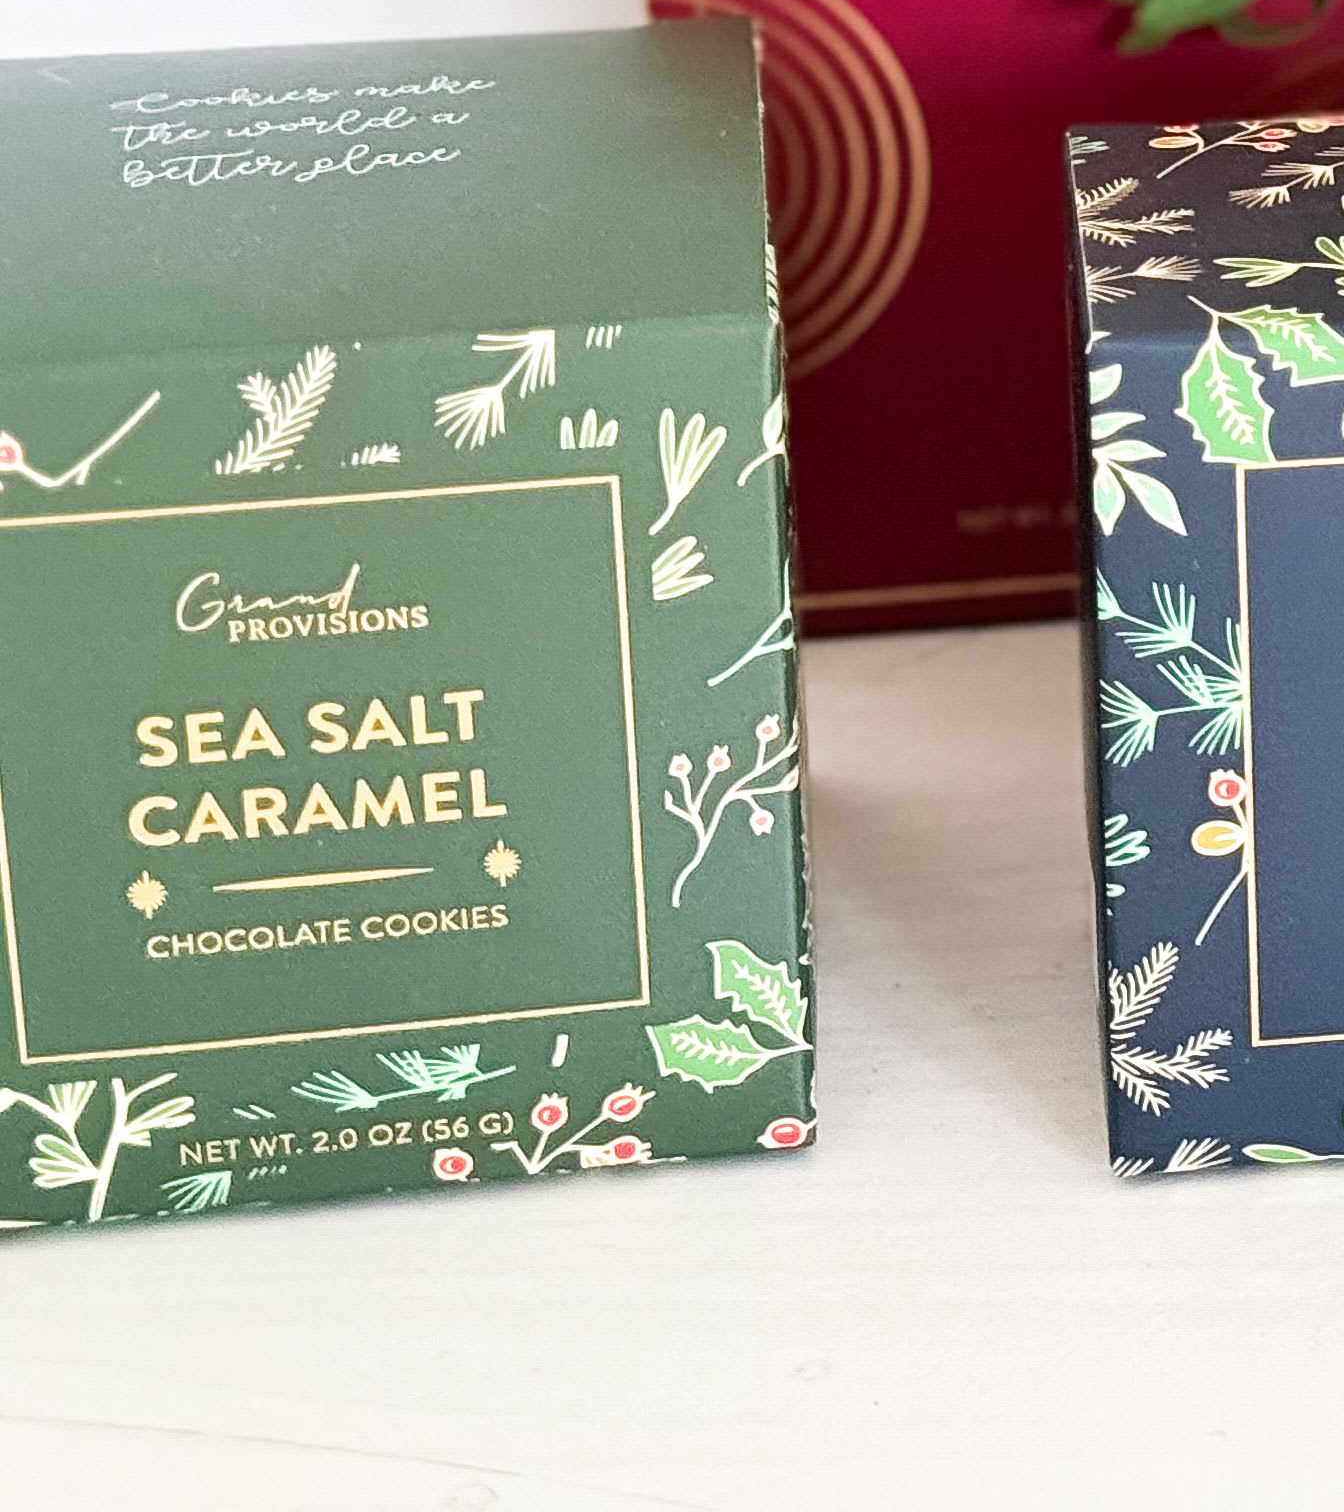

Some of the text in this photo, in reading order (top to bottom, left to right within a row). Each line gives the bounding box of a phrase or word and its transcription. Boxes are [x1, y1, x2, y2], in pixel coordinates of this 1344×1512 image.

[110, 74, 497, 113] Cookies make
[110, 107, 471, 151] the world a
[294, 143, 464, 183] place
[176, 563, 360, 633] Grand
[228, 604, 429, 643] PROVISIONS
[136, 689, 485, 768] SEA SALT
[128, 768, 508, 847] CARAMEL
[146, 904, 510, 960] CHOCOLATE COOKIES
[179, 1111, 514, 1167] NET WT. 2.0 OZ (56 G)
